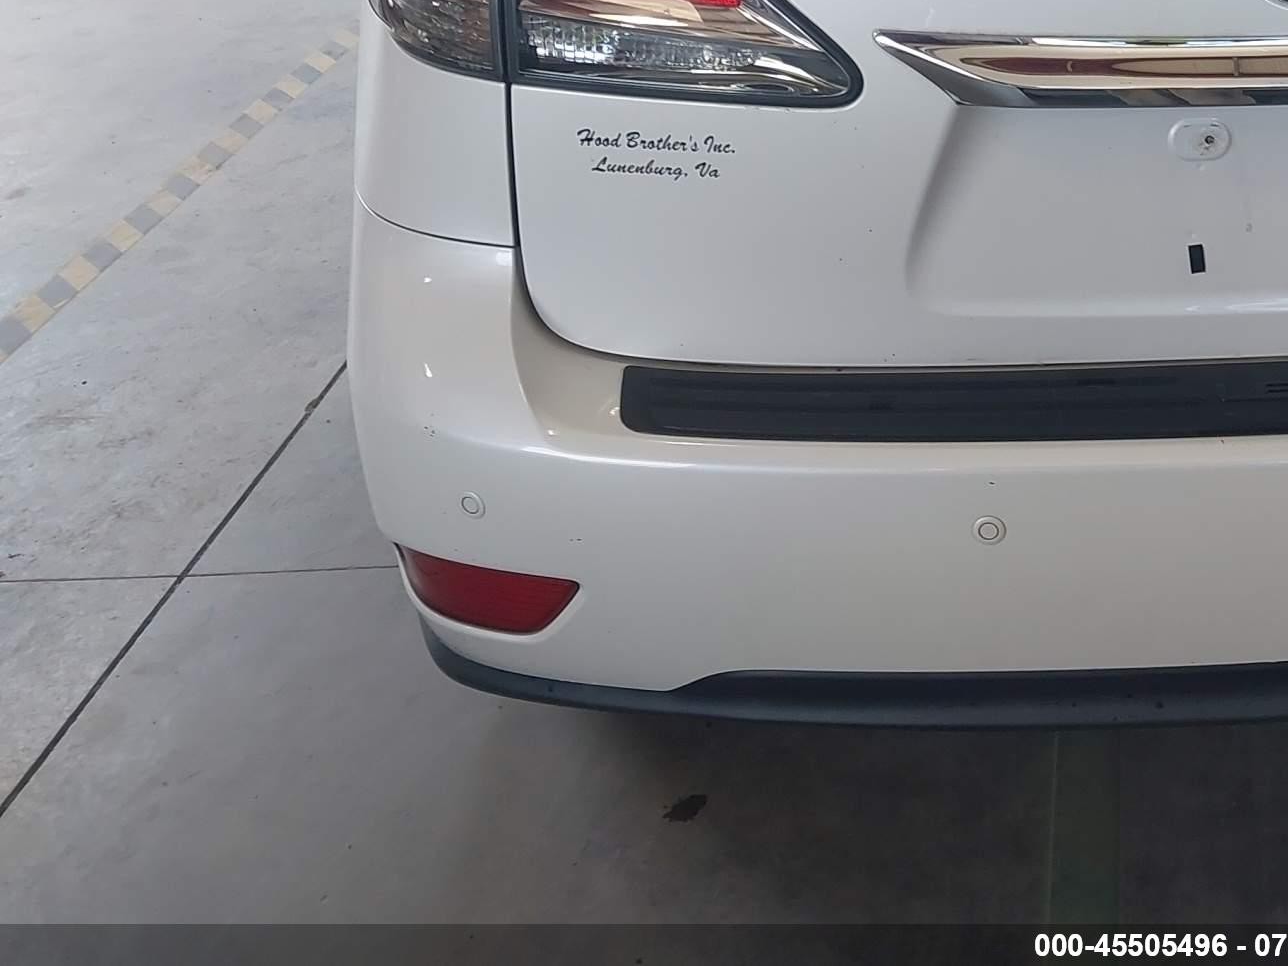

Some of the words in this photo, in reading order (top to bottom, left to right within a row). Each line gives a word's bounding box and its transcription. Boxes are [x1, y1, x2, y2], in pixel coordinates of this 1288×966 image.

[576, 129, 622, 148] Hood
[625, 131, 700, 153] Brother's
[703, 135, 736, 154] Inc.
[694, 162, 721, 179] Va
